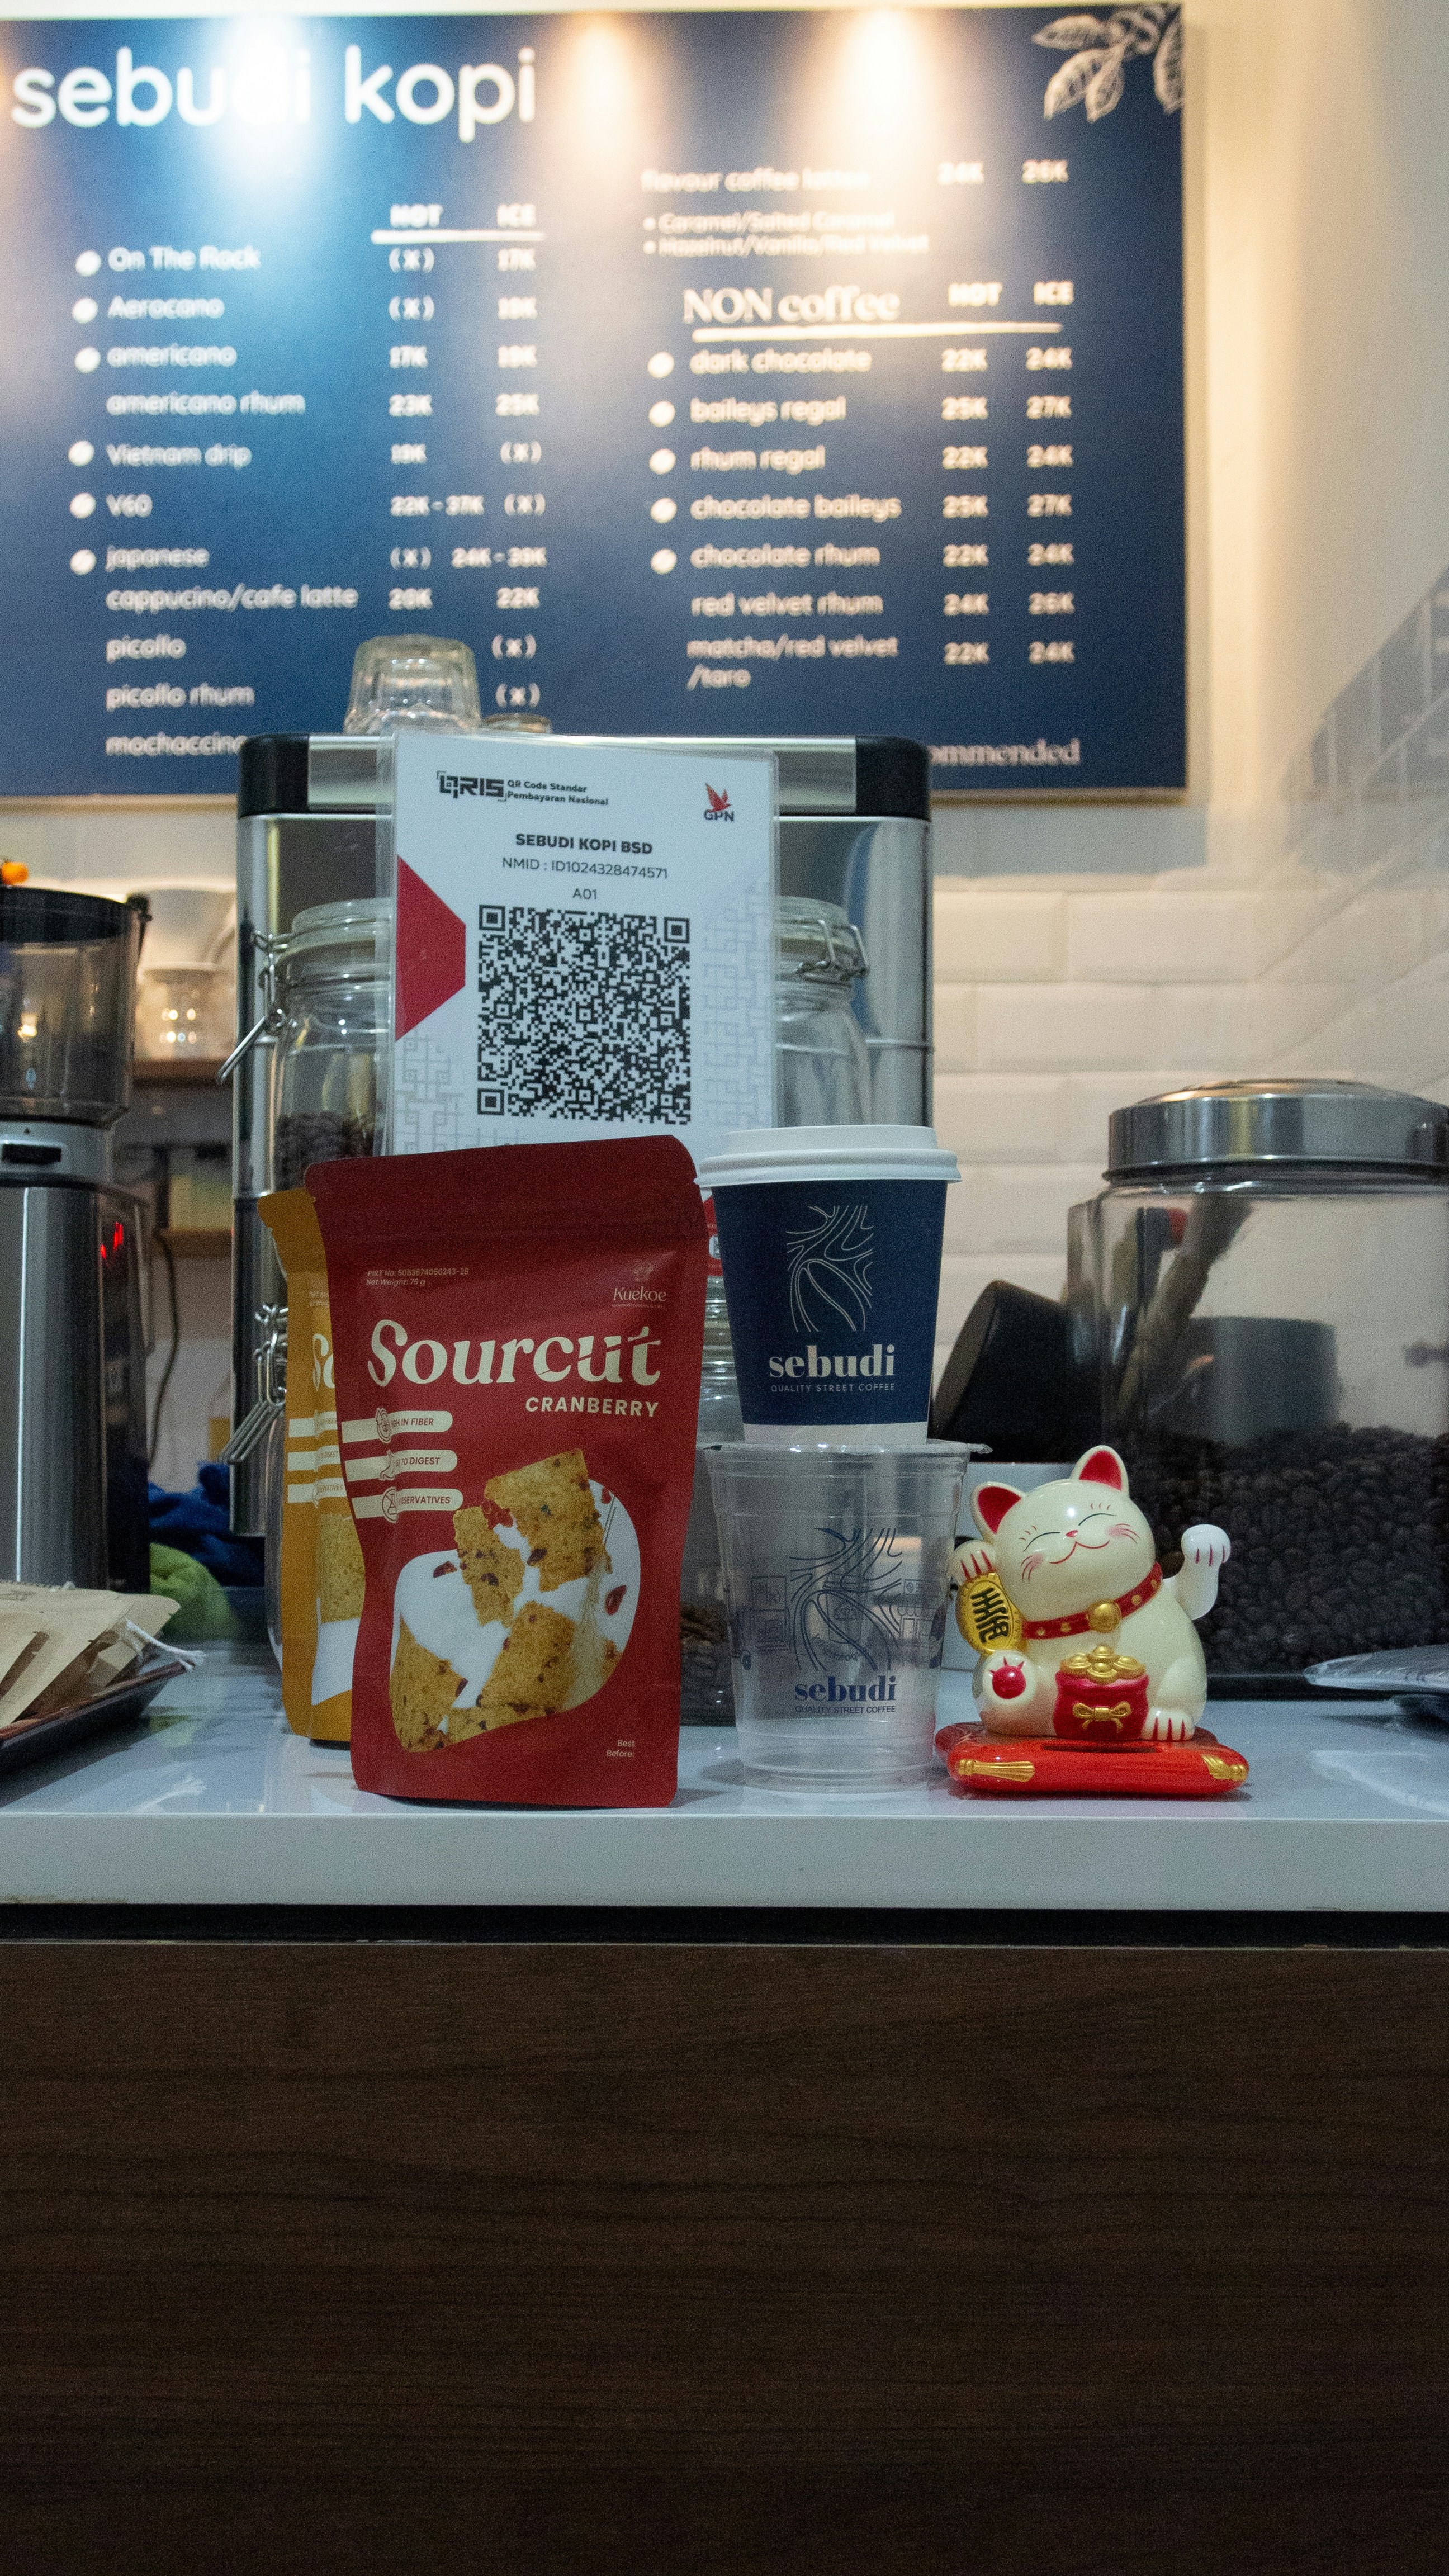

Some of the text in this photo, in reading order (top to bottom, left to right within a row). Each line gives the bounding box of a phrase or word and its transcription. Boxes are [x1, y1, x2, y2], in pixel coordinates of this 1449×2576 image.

[345, 45, 535, 143] kopi
[725, 168, 799, 192] coffee
[497, 205, 536, 226] ICE
[108, 247, 144, 269] On
[150, 246, 195, 269] The
[684, 285, 900, 323] NON coffee
[948, 282, 1002, 305] HOT
[1034, 281, 1074, 304] ICE
[108, 296, 224, 319] Aerocano
[107, 343, 237, 367] americano
[690, 348, 872, 374] dark chocolate
[942, 349, 987, 372] 22K
[107, 390, 306, 415] americano rhum
[690, 396, 846, 427] baileys regal
[1026, 396, 1071, 419] 27K
[107, 443, 252, 470] Vietnam drip
[691, 446, 826, 475] rhum regal
[107, 494, 153, 518] V60
[691, 494, 902, 522] chocolate baileys
[1027, 494, 1072, 517] 27K
[107, 546, 210, 572] japanese
[691, 543, 880, 569] chocolate rhum
[300, 585, 359, 609] latte
[692, 591, 883, 617] red velvet rhum
[107, 634, 186, 663] picollo
[828, 636, 899, 659] velvet
[107, 683, 255, 712] picollo rhum
[929, 737, 1081, 766] ommended
[439, 774, 504, 798] QRIS
[507, 779, 587, 793] QR Code Standar
[507, 790, 609, 806] Pembayaran Nasional
[704, 809, 735, 822] GPN
[515, 832, 653, 855] SEBUDI KOPI BSD
[503, 857, 540, 872] NMID
[552, 860, 668, 879] ID1024328474571
[572, 888, 598, 900] A01
[613, 1286, 667, 1302] Kuekoe
[367, 1318, 662, 1388] Sourcut
[769, 1344, 895, 1378] sebudi
[816, 1384, 854, 1392] STREET
[858, 1383, 895, 1391] COFFEE
[525, 1395, 659, 1418] CRANBERRY
[409, 1457, 441, 1465] DIGEST
[794, 1675, 897, 1702] sebudi
[617, 1739, 635, 1748] Best
